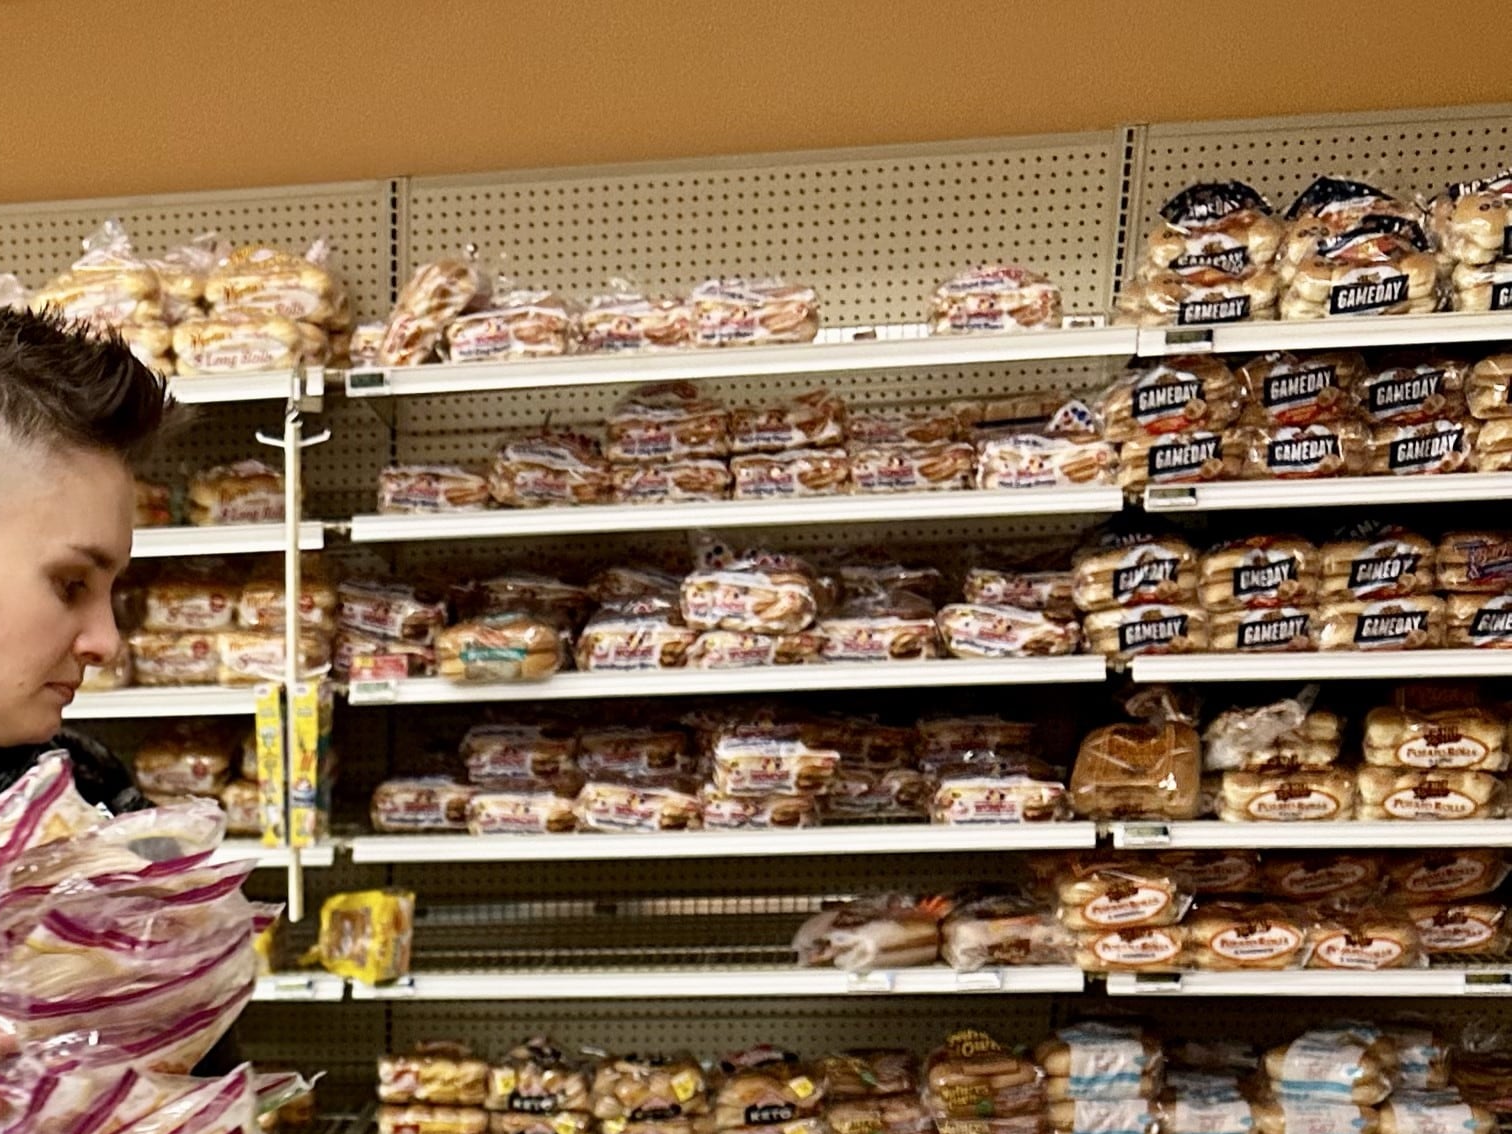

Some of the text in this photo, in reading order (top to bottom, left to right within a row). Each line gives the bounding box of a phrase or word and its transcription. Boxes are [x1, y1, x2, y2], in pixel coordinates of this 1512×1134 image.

[1338, 282, 1402, 308] GAMEDAY
[1139, 384, 1198, 409] GAMEDAY
[1271, 374, 1331, 399] GAMEDAY
[1376, 379, 1438, 405] GAMEDAY
[1155, 443, 1216, 467] GAMEDAY
[1275, 439, 1334, 461] GAMEDAY
[1397, 435, 1457, 462] GAMEDAY
[1125, 619, 1182, 645] GAMEDAY
[1245, 619, 1303, 643] GAMEDAY
[1362, 616, 1420, 637] GAMEDAY
